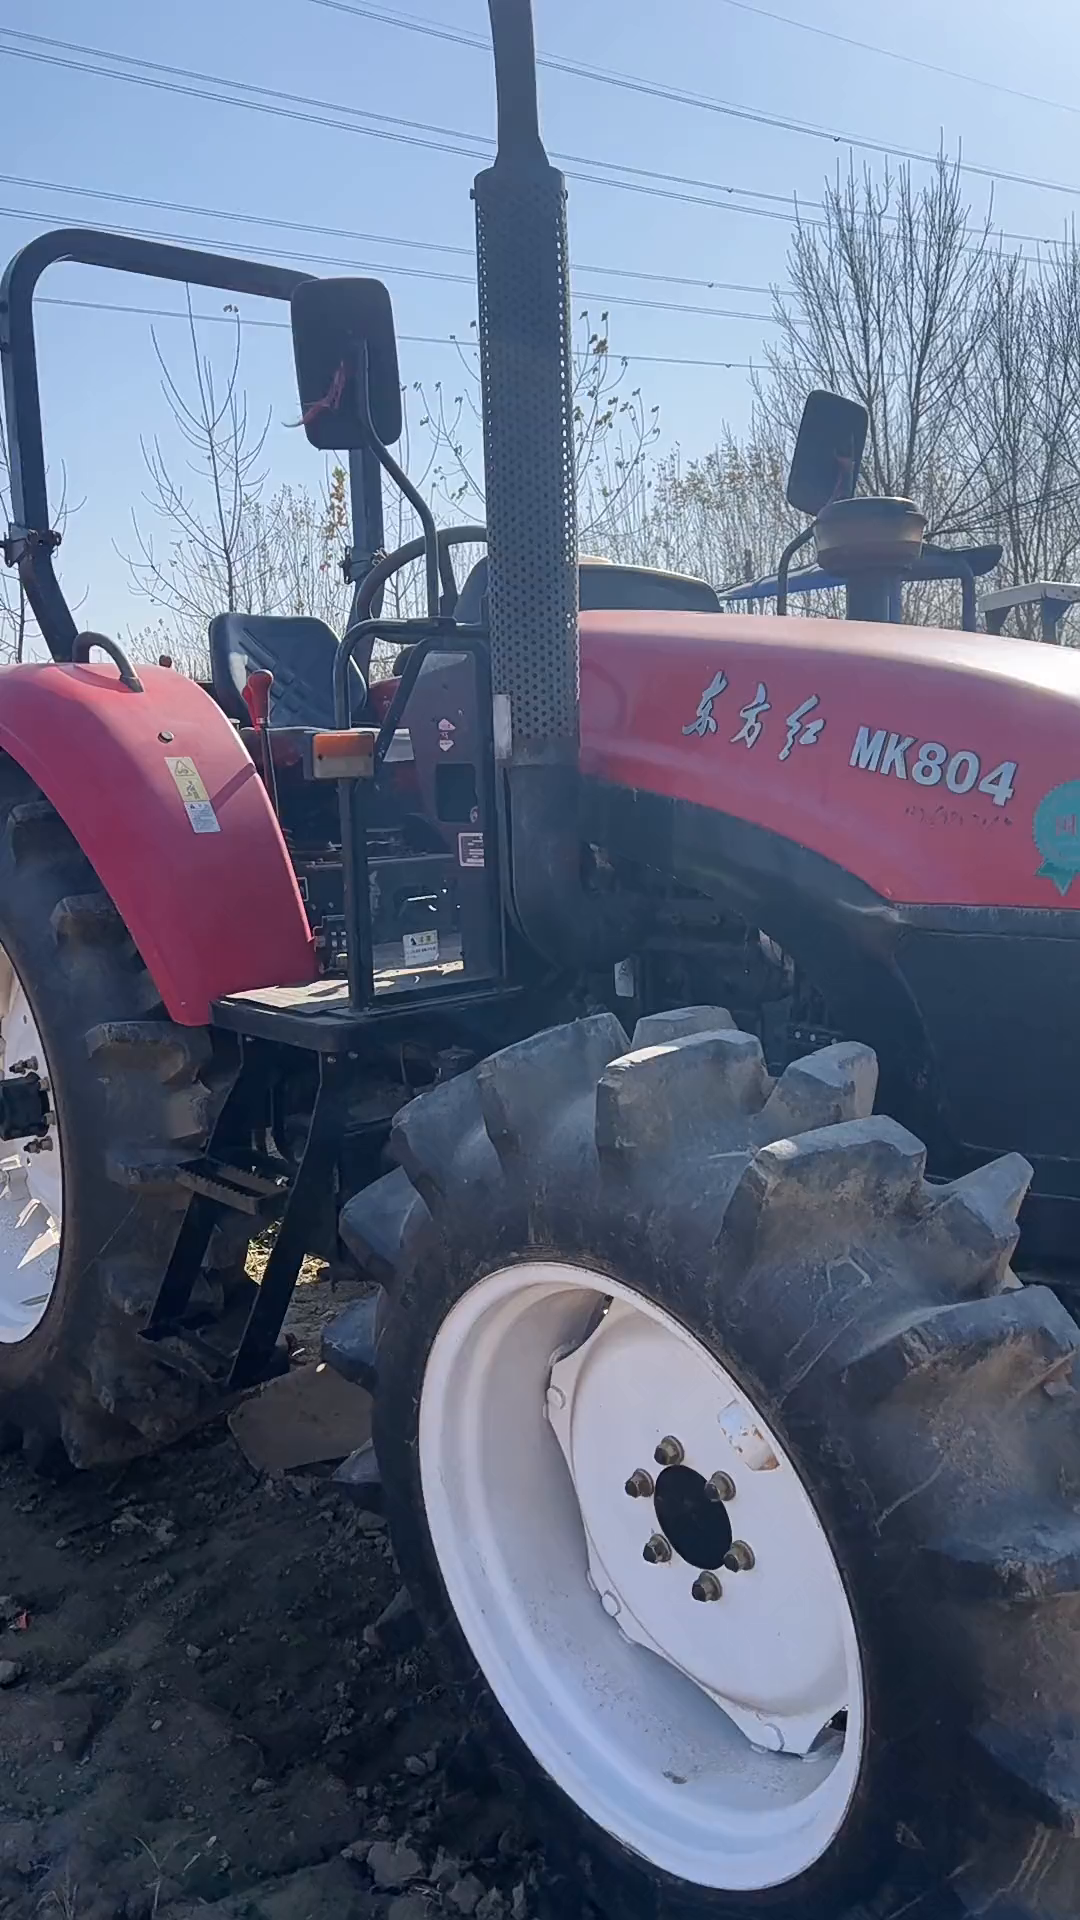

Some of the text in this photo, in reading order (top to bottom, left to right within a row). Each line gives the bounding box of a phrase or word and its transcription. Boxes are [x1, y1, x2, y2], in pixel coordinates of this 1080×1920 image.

[682, 670, 1018, 807] 东方红 MK804
